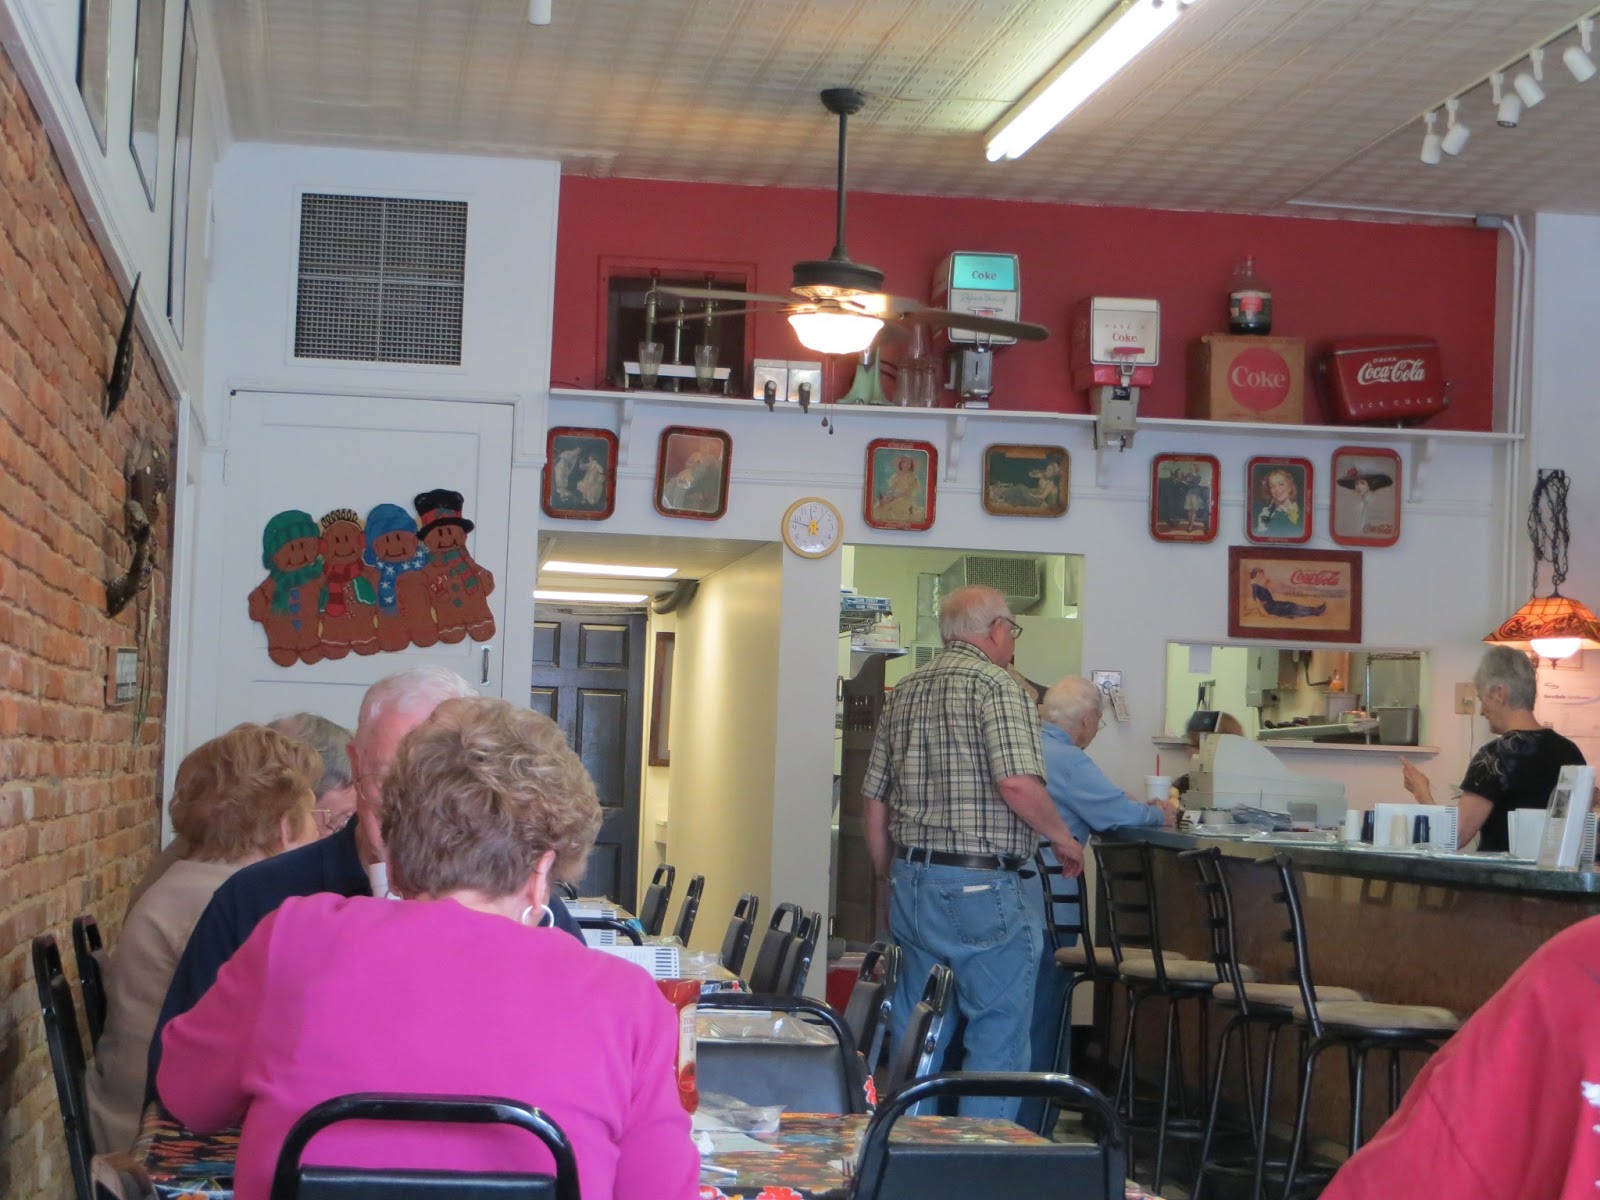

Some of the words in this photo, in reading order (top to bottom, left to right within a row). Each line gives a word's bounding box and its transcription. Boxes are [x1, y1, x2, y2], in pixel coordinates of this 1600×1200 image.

[971, 270, 997, 280] Coke
[1112, 332, 1138, 342] Coke
[1231, 366, 1286, 388] Coke
[1357, 358, 1425, 385] Coca-Cola
